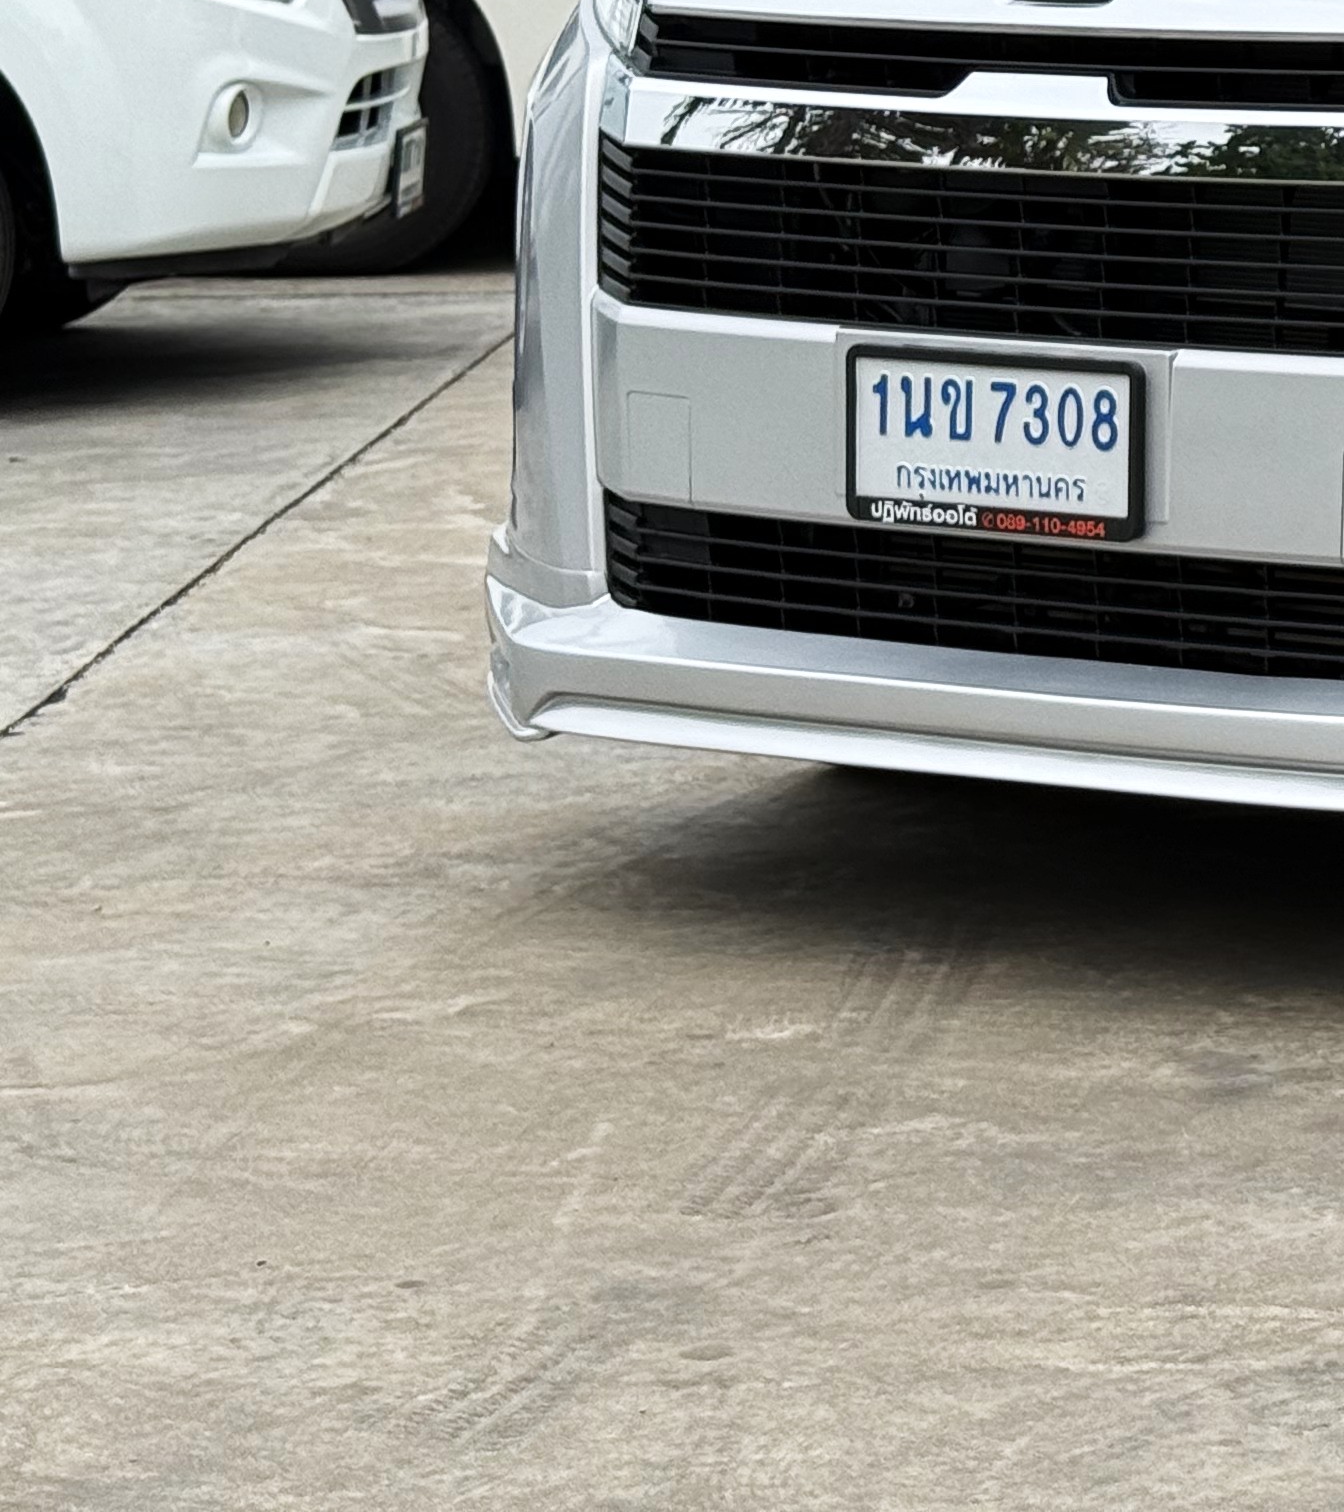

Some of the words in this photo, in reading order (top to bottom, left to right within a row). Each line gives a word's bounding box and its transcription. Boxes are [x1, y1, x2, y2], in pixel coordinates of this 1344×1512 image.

[872, 373, 974, 441] 1นข
[990, 380, 1118, 451] 7308
[896, 464, 1087, 501] กรุงเทพมหานคร
[996, 512, 1106, 537] 089-110-4954
